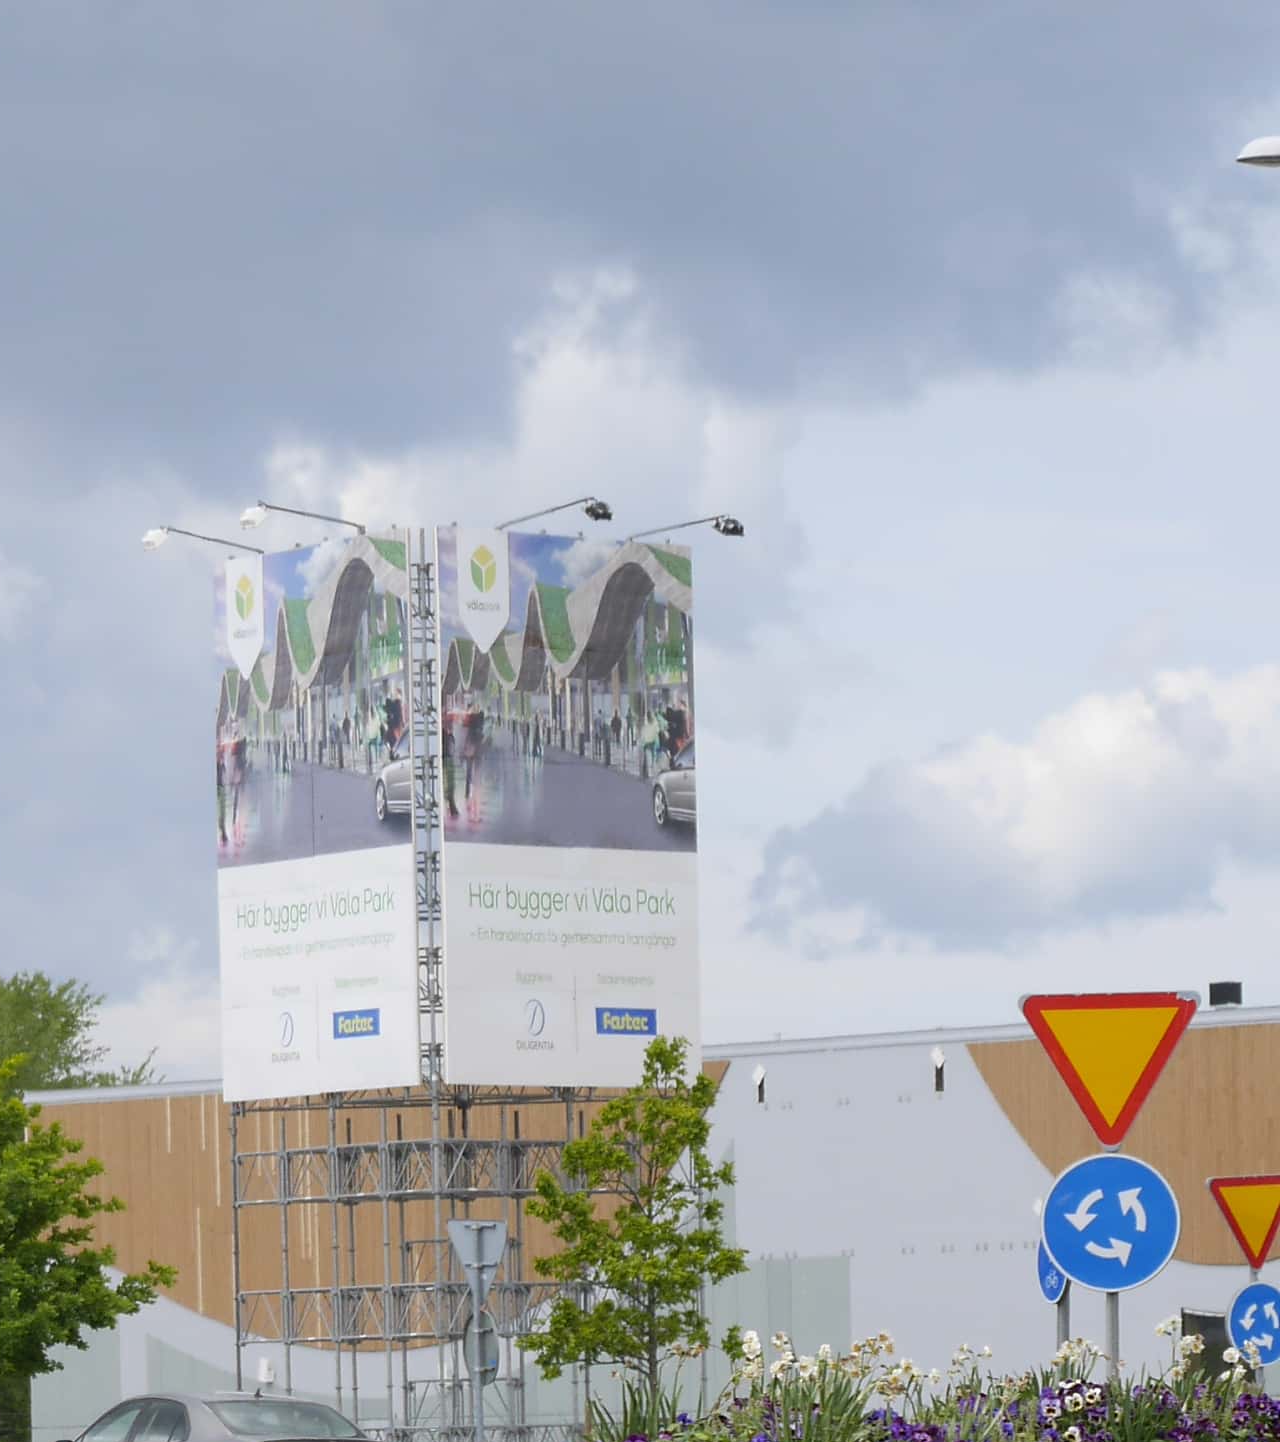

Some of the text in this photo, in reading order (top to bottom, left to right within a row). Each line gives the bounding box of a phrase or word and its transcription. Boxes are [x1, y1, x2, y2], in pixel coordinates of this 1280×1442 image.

[236, 903, 260, 928] Här
[263, 900, 312, 933] bygger
[315, 894, 328, 919] vi
[364, 886, 395, 912] Park
[468, 882, 676, 919] Här bygger vi Väla Park
